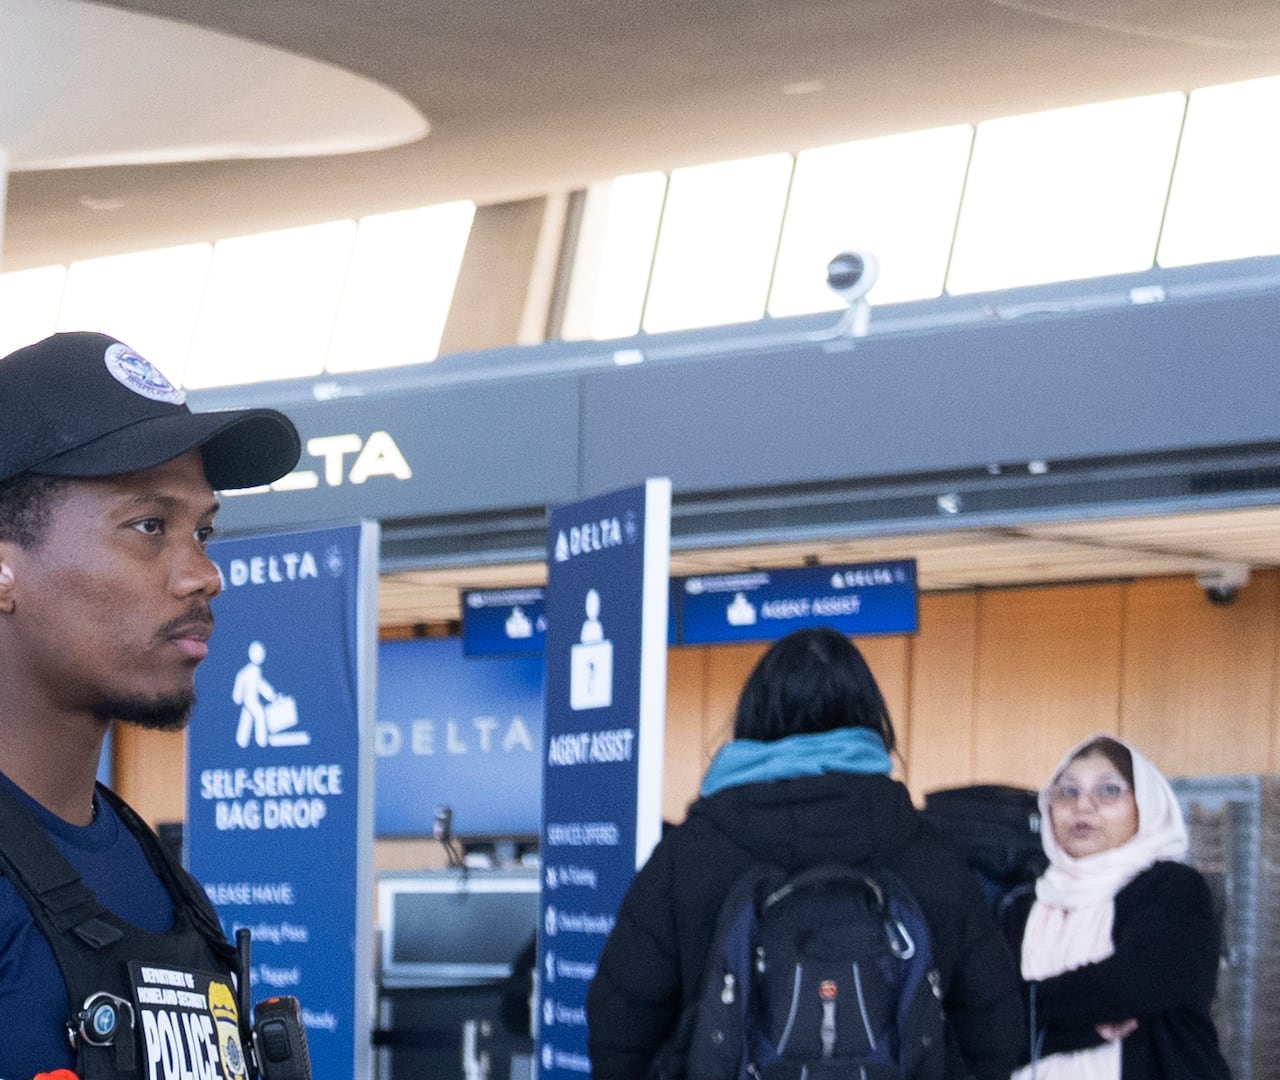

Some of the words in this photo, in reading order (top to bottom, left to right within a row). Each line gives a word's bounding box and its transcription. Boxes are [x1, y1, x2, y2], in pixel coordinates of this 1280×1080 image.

[570, 516, 623, 556] DELTA
[230, 552, 318, 586] DELTA
[374, 706, 533, 757] DELTA
[548, 732, 590, 767] AGENT
[589, 728, 634, 763] ASSIST
[201, 765, 343, 799] SELF-SERVICE
[215, 801, 261, 830] BAG
[263, 799, 326, 829] DROP
